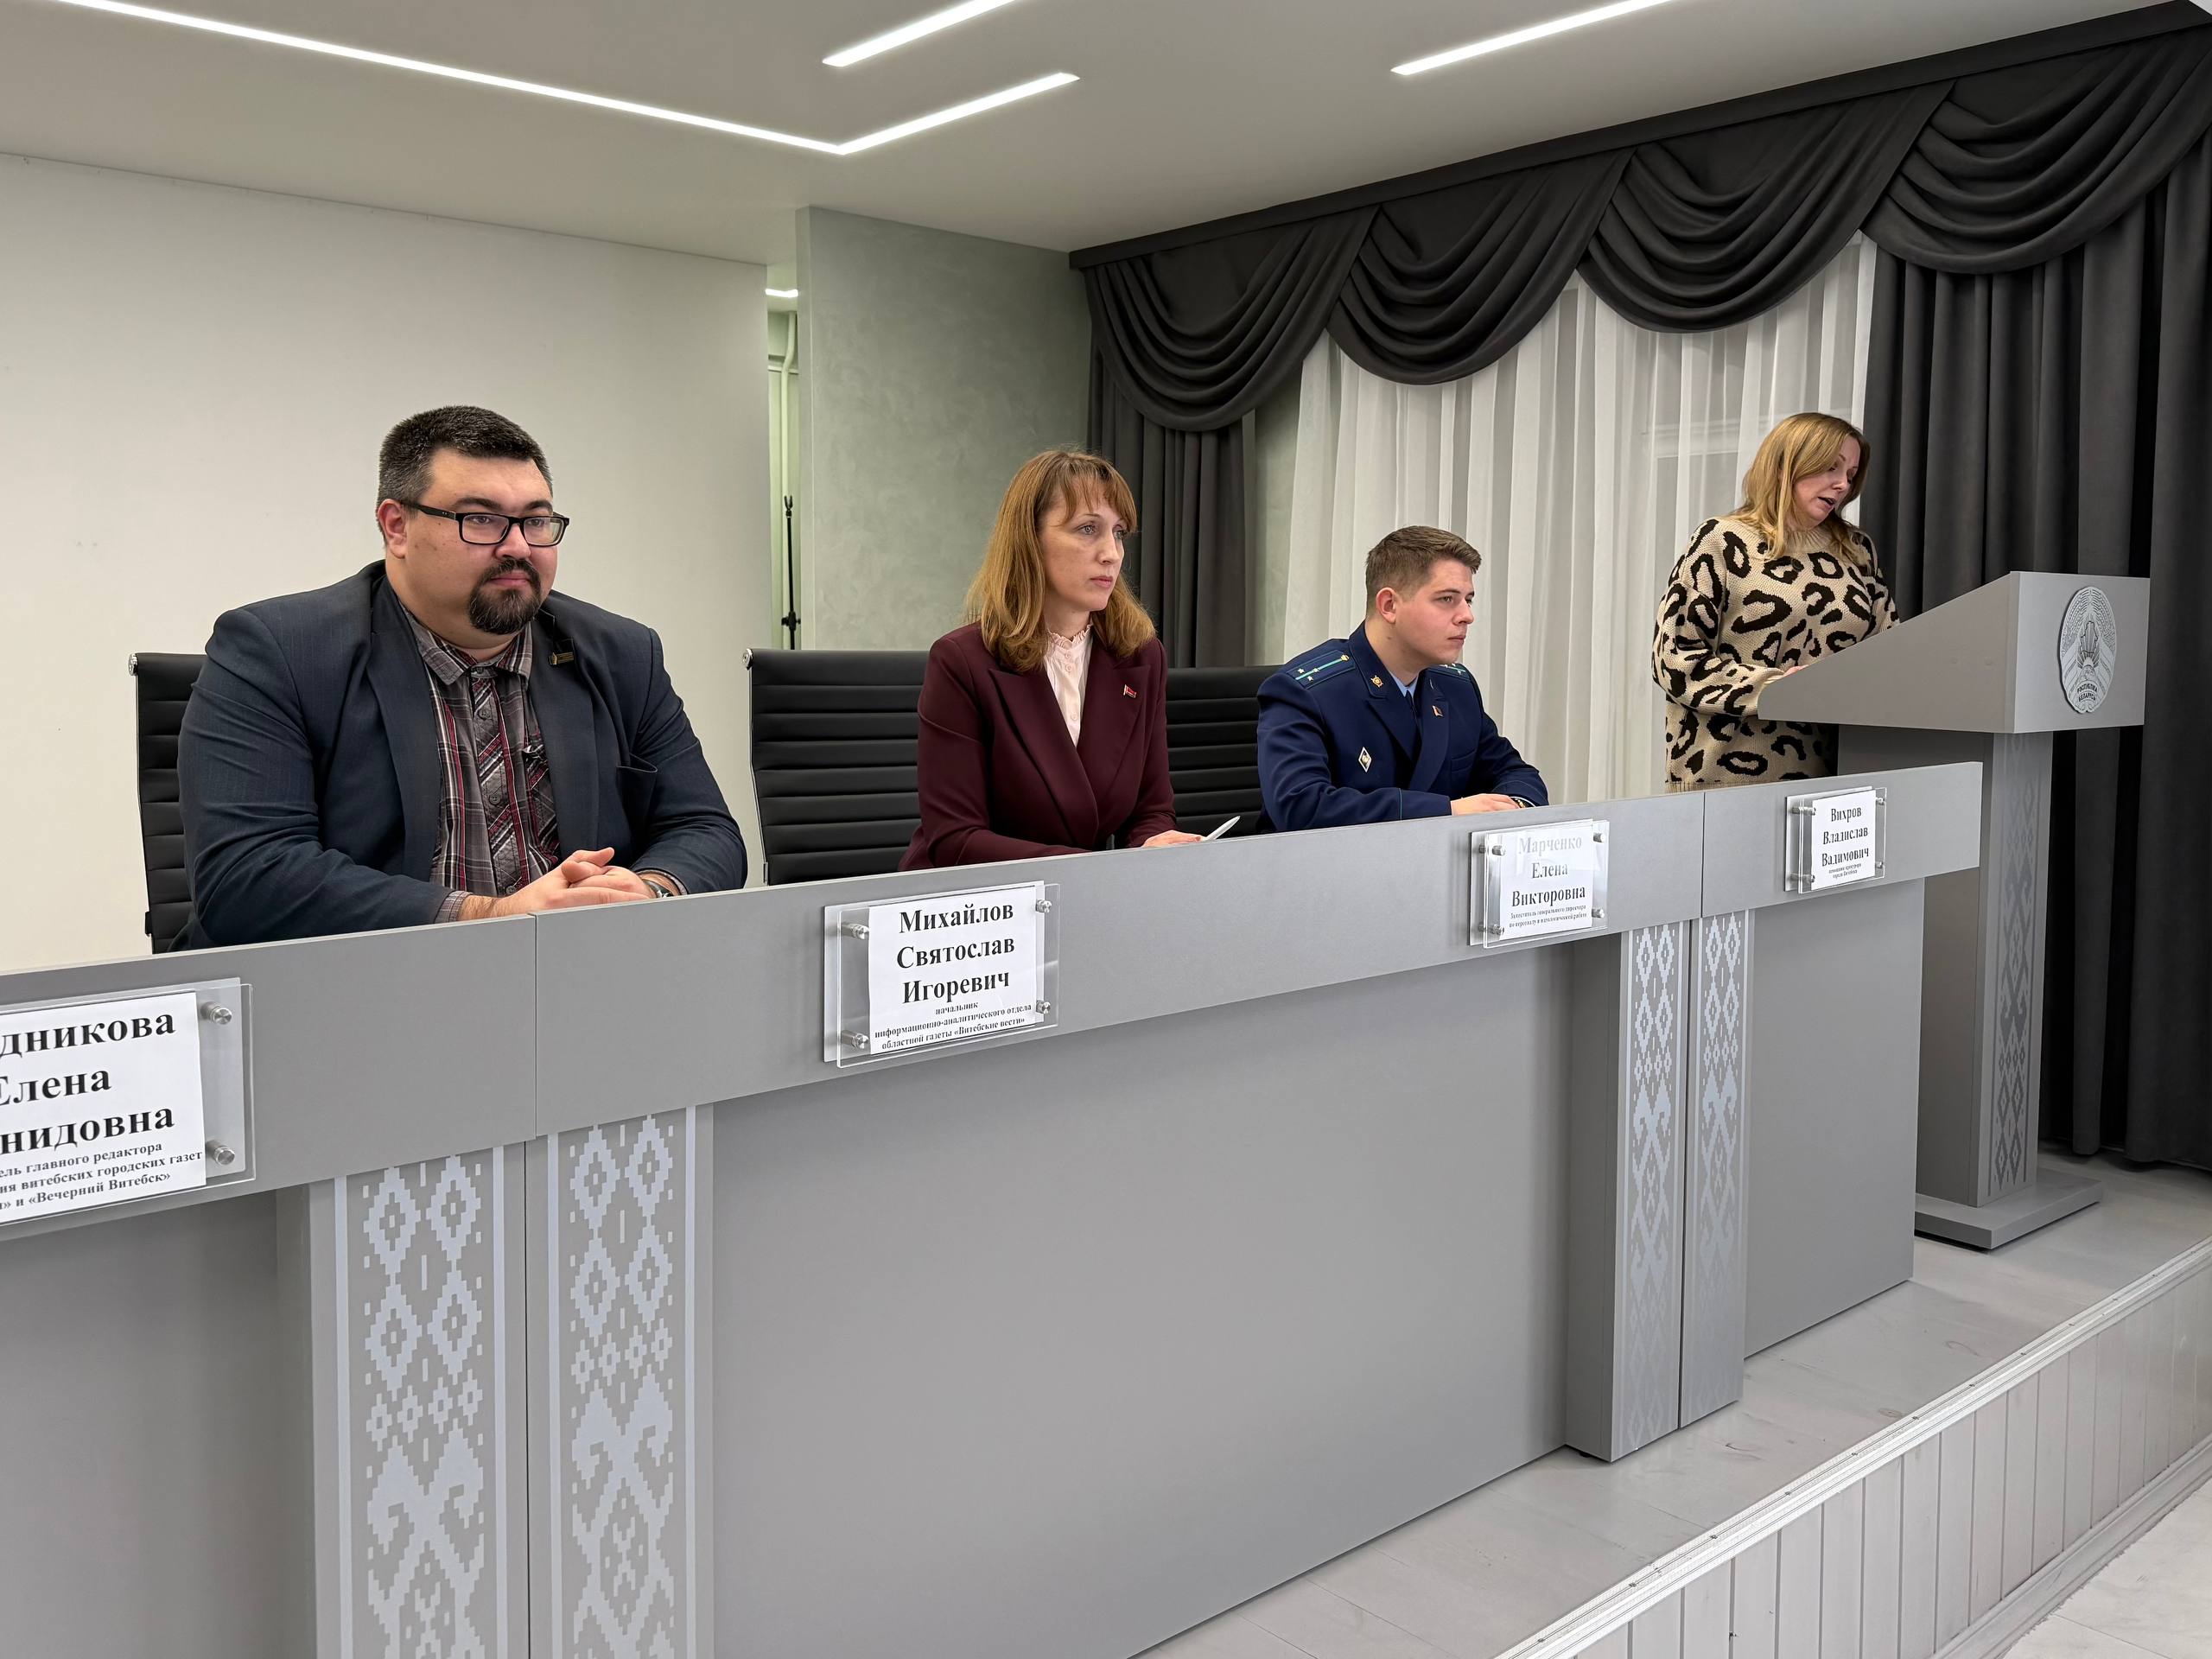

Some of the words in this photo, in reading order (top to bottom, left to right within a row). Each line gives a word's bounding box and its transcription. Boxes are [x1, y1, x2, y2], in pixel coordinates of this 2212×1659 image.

[1831, 807, 1862, 823] Вихров
[1518, 836, 1582, 856] Марченко
[1823, 827, 1868, 844] Владислав
[1531, 862, 1568, 879] Елена
[1821, 848, 1869, 867] Вадимович
[1512, 887, 1586, 906] Викторовна
[899, 903, 1014, 933] Михайлов
[896, 938, 1015, 969] Святослав
[902, 972, 1010, 1003] Игоревич
[874, 1009, 1005, 1039] информационно-аналитического
[1007, 1004, 1032, 1014] отдела
[935, 1002, 978, 1015] начальник
[881, 1034, 924, 1050] областной
[925, 1031, 952, 1041] газеты
[954, 1020, 999, 1035] «Витебские
[1000, 1018, 1025, 1027] вести»
[0, 1107, 175, 1154] нидовна
[22, 1171, 93, 1190] витебских
[98, 1158, 166, 1177] городских
[169, 1151, 203, 1165] газет
[26, 1156, 90, 1173] главного
[93, 1143, 162, 1165] редактора
[16, 1198, 24, 1207] и
[29, 1182, 104, 1205] «Вечерний
[108, 1173, 170, 1191] Витебск»
